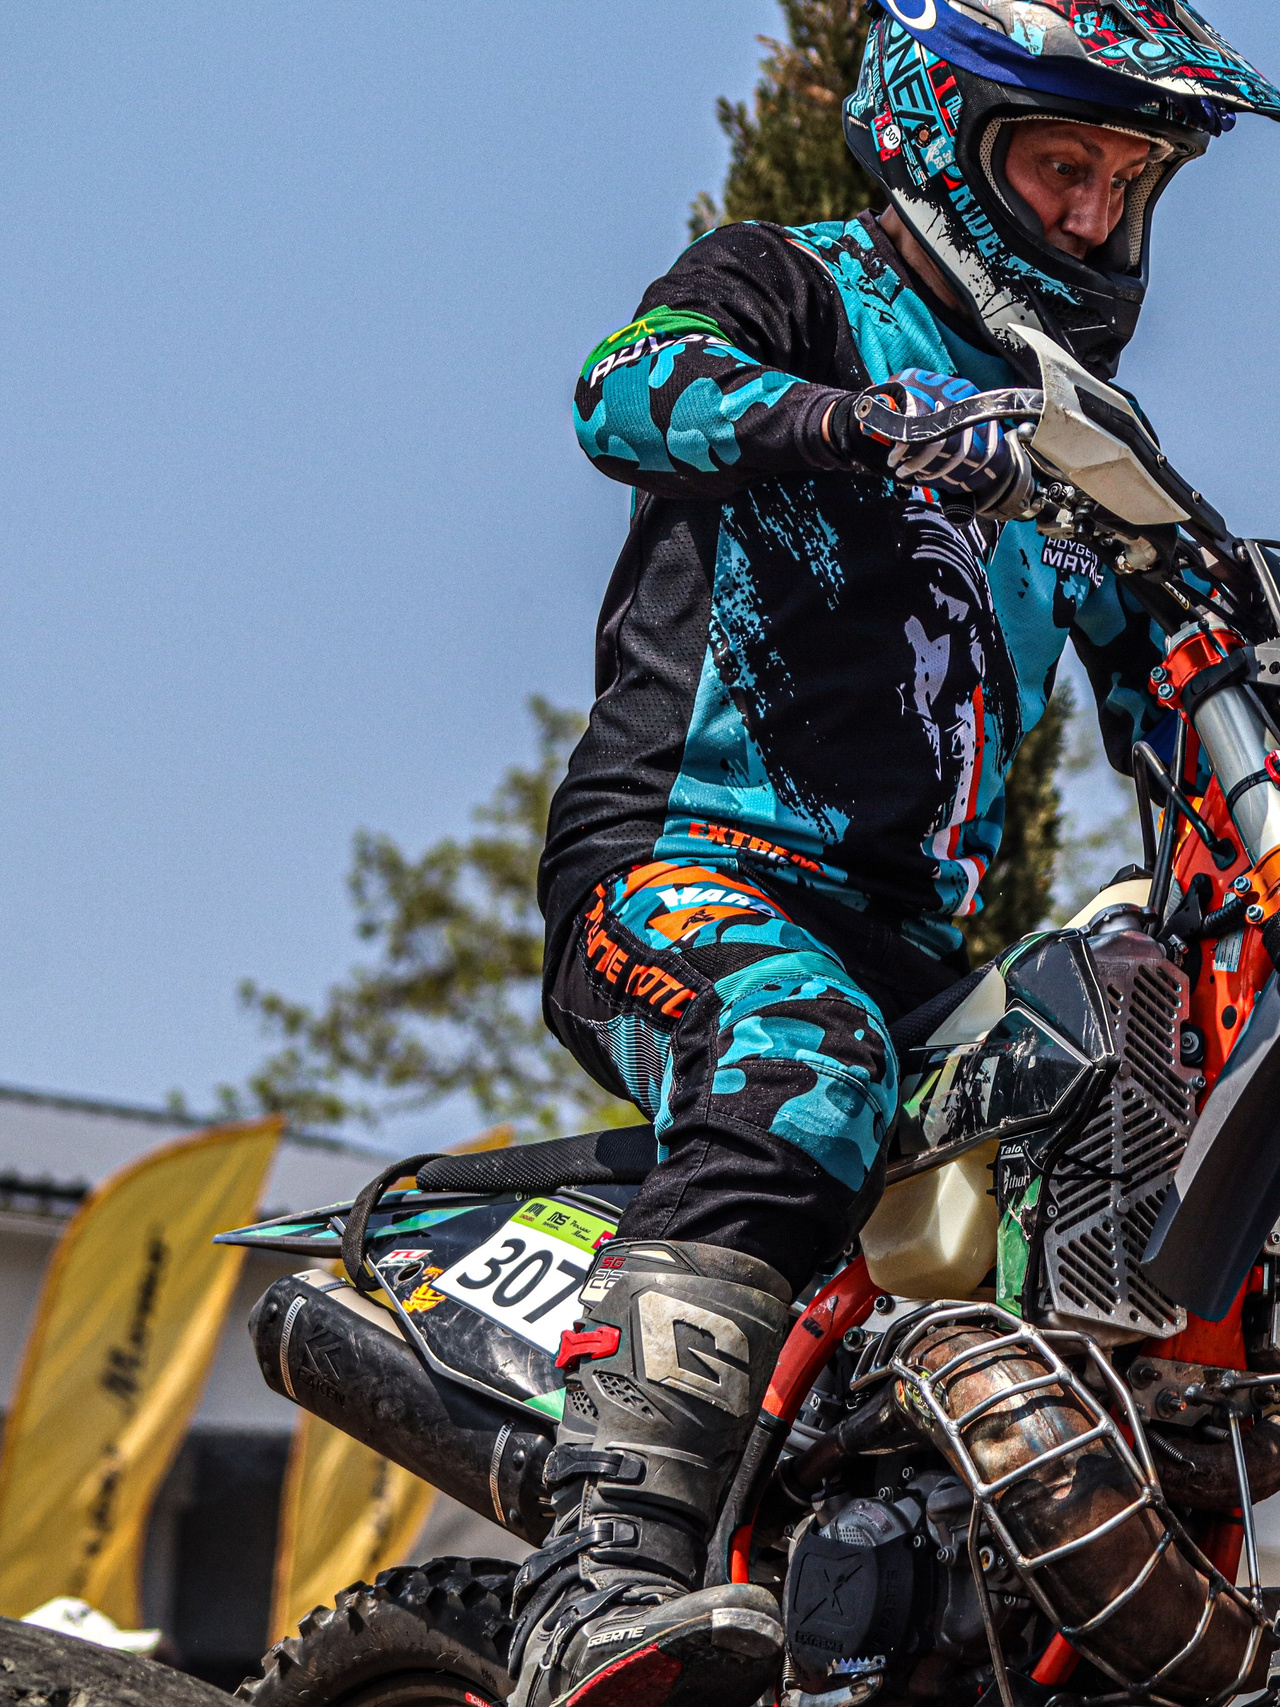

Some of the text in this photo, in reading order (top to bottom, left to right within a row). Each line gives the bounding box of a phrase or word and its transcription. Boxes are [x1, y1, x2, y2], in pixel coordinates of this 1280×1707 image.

[885, 127, 899, 145] 307
[1000, 1143, 1024, 1156] Talo
[600, 1256, 627, 1269] SG
[455, 1237, 588, 1324] 307
